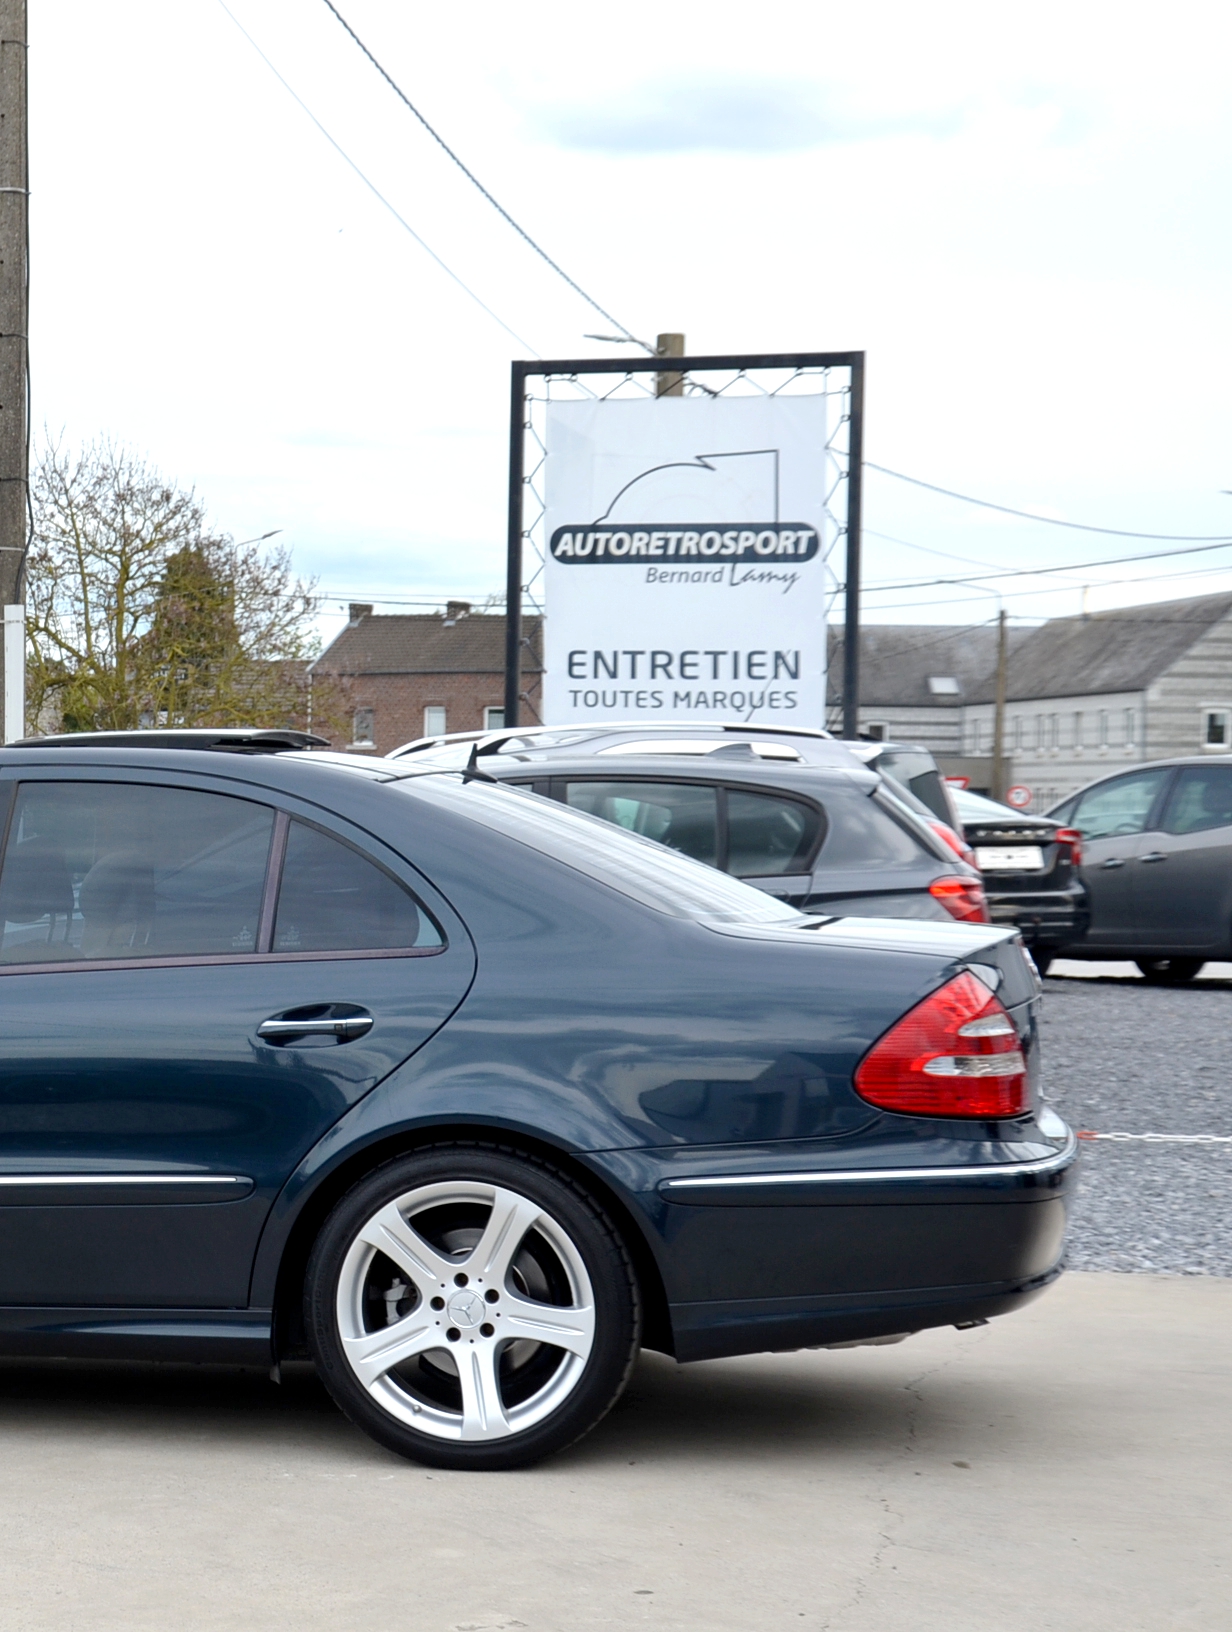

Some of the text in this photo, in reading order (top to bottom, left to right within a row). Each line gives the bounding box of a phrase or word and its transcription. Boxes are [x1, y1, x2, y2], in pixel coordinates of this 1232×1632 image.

[554, 529, 815, 557] AUTORETROSPORT
[645, 566, 725, 583] Bernard
[567, 650, 801, 680] ENTRETIEN
[568, 690, 798, 712] TOUTES MARQUES
